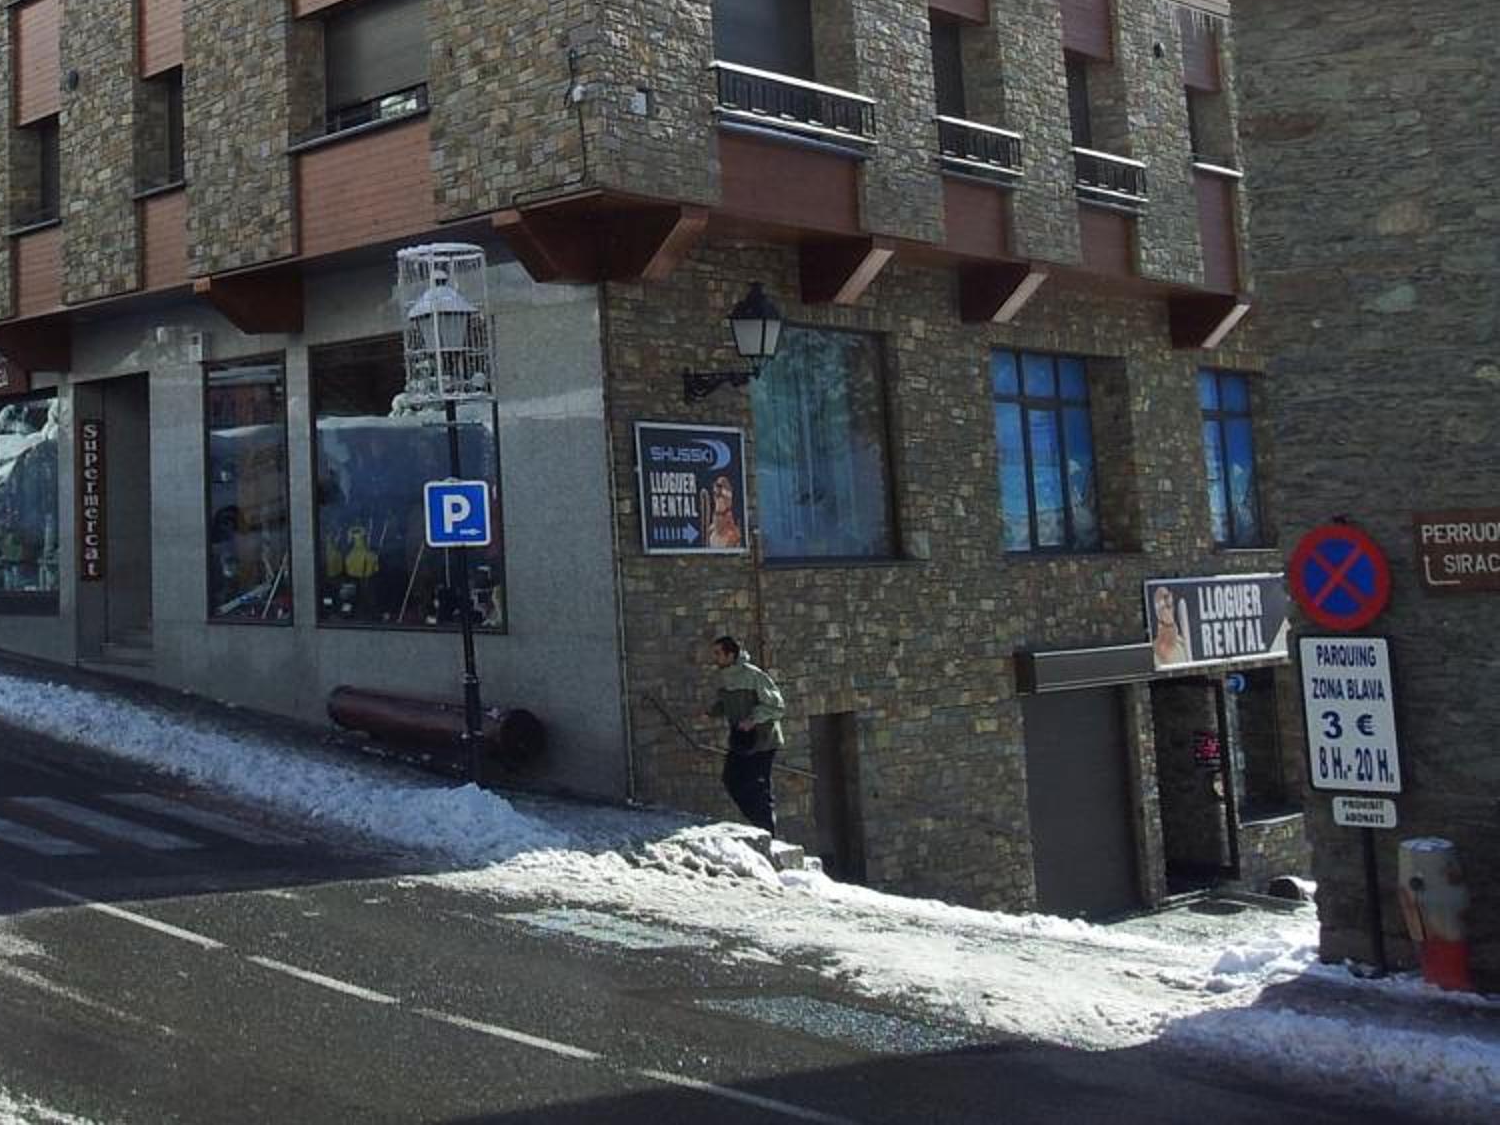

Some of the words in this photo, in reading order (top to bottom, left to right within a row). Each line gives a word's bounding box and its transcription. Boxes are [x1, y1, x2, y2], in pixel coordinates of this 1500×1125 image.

[650, 472, 697, 494] LLOGUER
[83, 425, 100, 576] Supermercat
[443, 494, 471, 533] P
[651, 495, 699, 517] RENTAL
[1421, 522, 1500, 544] PERRUO
[1198, 584, 1263, 620] LLOGUER
[1201, 618, 1267, 657] RENTAL
[1316, 645, 1377, 667] PARQUING
[1312, 678, 1344, 700] ZONA
[1347, 679, 1386, 701] BLAVA
[1321, 711, 1343, 739] 3
[1355, 748, 1373, 782] 20
